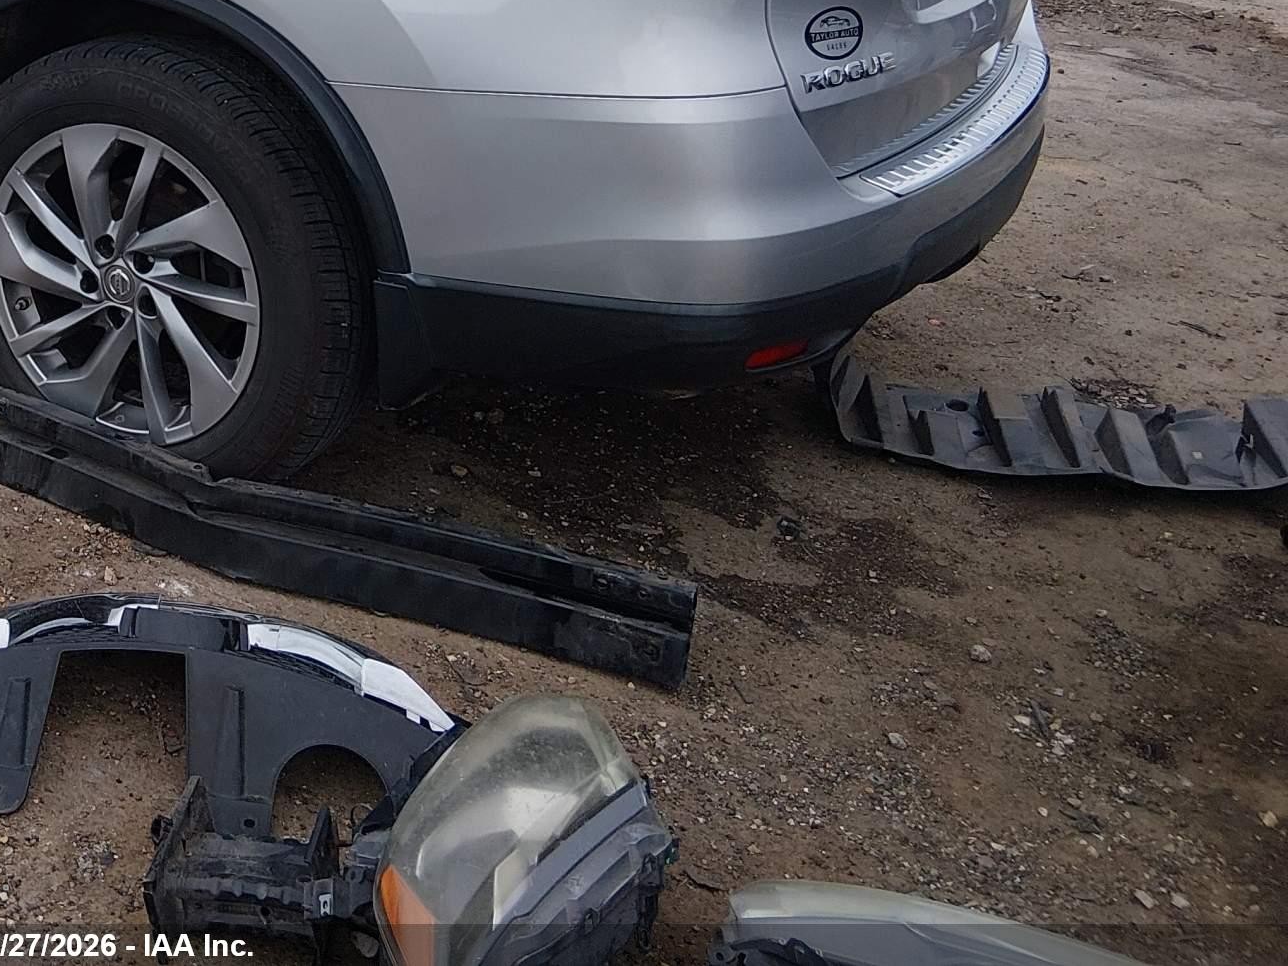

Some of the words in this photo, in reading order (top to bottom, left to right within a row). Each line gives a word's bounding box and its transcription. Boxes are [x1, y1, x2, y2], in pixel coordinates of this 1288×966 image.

[810, 32, 839, 42] TAYLOR
[841, 28, 859, 37] AUTO
[800, 52, 897, 94] ROGUE
